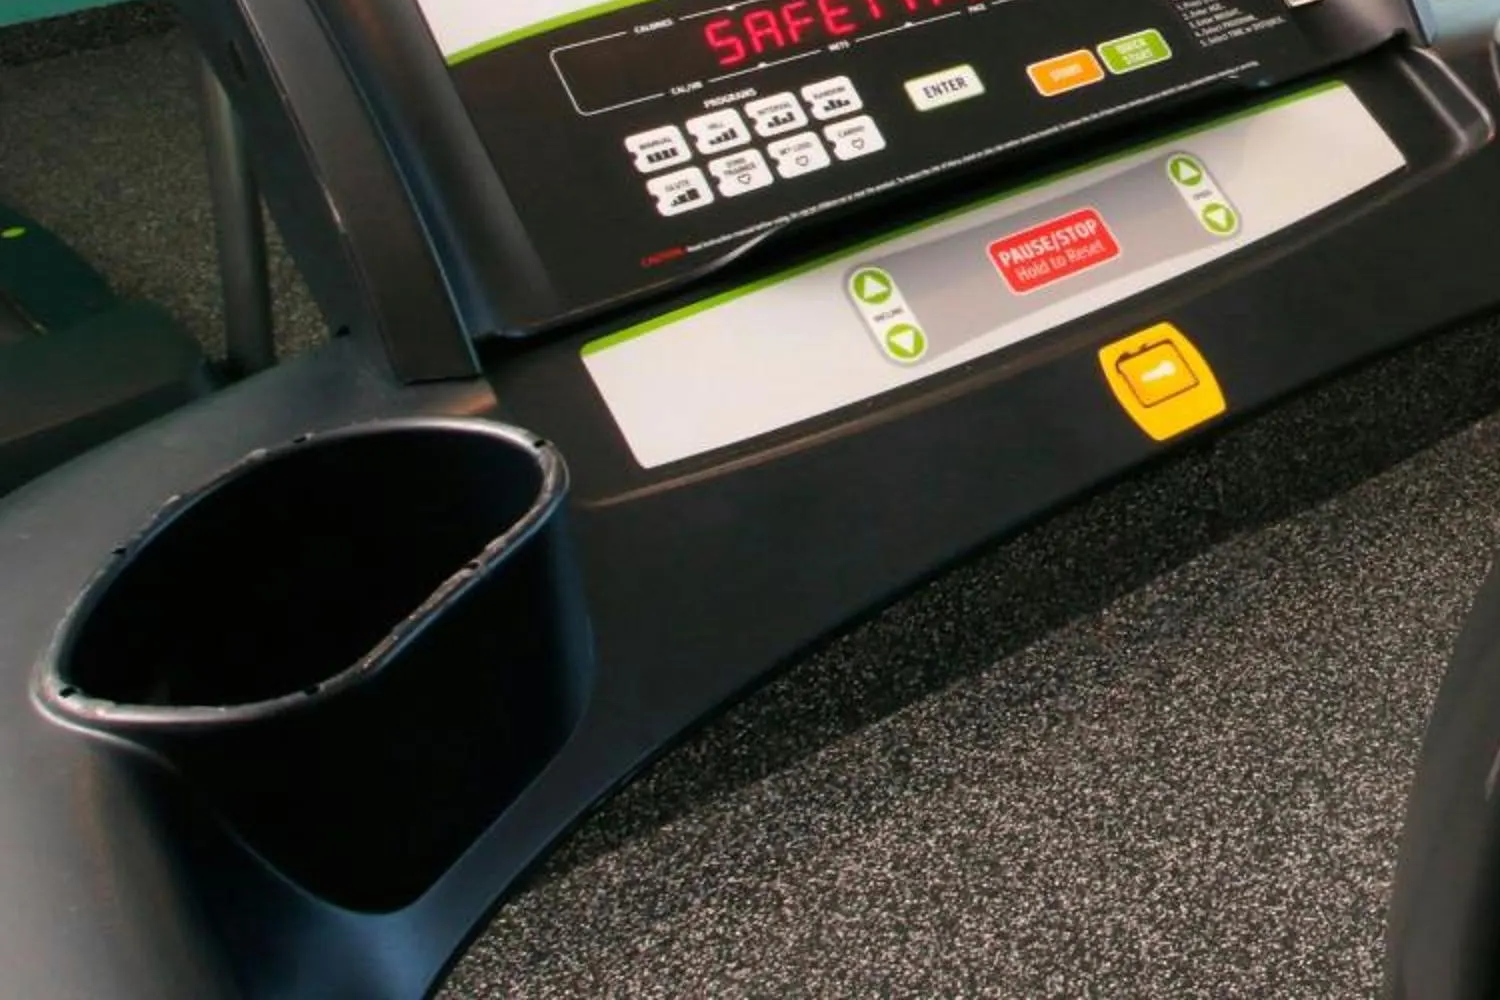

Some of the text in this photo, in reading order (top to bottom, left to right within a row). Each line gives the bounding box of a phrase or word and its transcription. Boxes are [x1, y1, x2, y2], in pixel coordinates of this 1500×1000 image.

[703, 87, 758, 108] PROGRAMS
[922, 76, 969, 99] ENTER
[997, 218, 1098, 268] PAUSE/STOP
[1014, 239, 1106, 281] Hold to Reset
